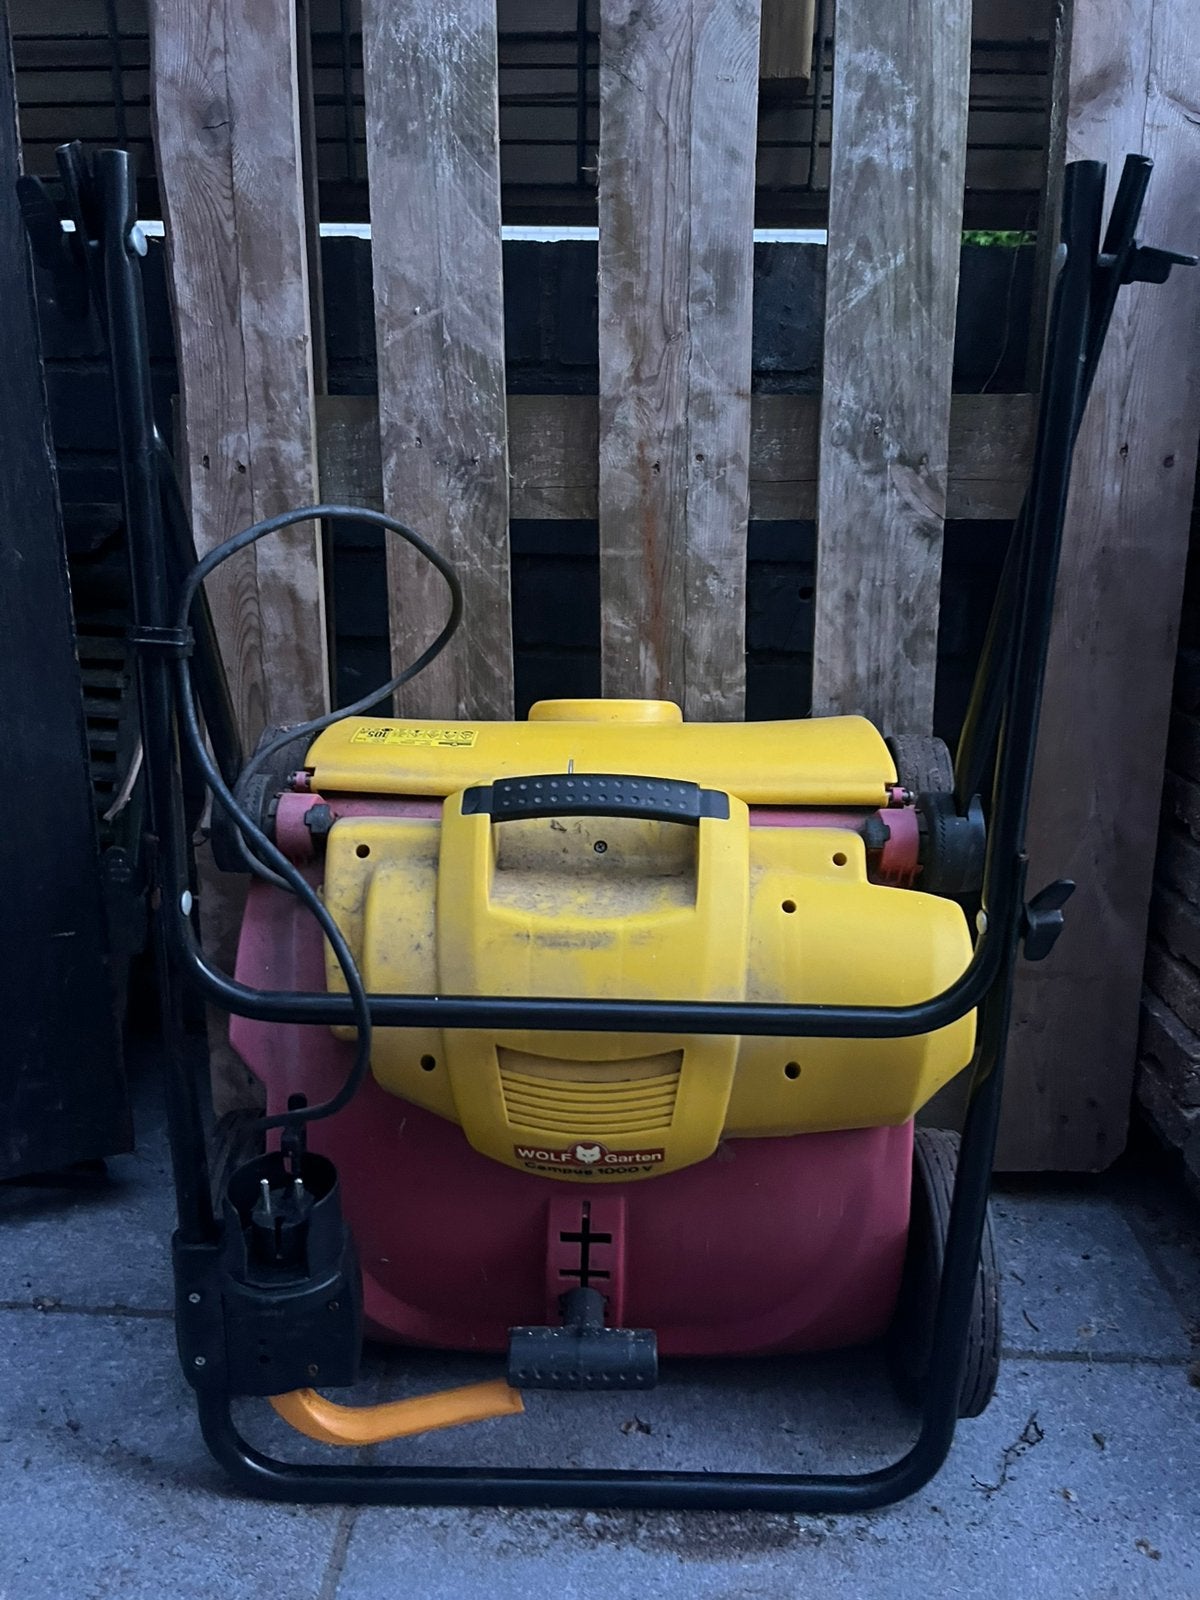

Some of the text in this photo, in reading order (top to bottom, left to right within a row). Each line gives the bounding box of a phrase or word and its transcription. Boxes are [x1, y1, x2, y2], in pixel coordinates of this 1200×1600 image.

[518, 1148, 662, 1163] WOLF Garten
[525, 1162, 593, 1175] Campus
[597, 1166, 636, 1175] 1000
